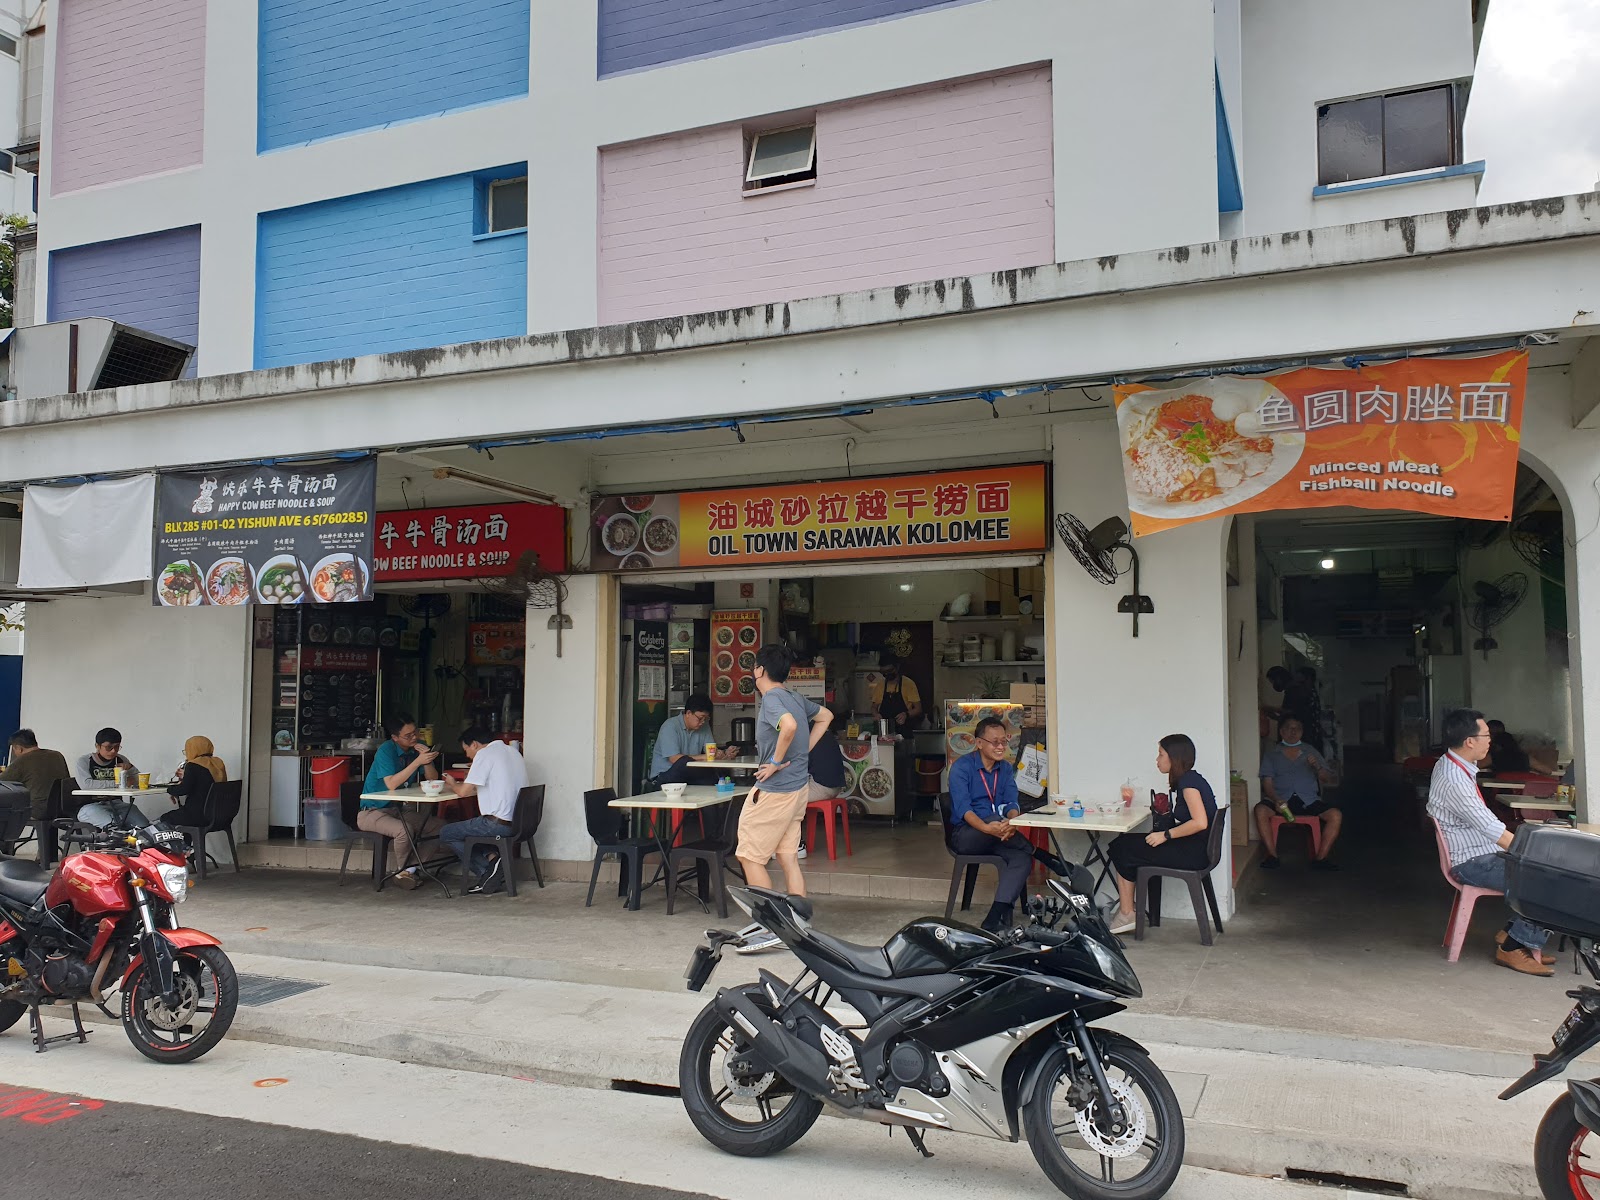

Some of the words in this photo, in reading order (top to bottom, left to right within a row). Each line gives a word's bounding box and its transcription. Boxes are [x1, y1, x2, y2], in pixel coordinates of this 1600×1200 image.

[1255, 382, 1511, 433] 鱼圆肉脞面
[1309, 461, 1381, 476] Minced
[1387, 459, 1440, 475] Meat
[222, 473, 338, 497] 快乐牛牛骨汤面
[1300, 476, 1376, 492] Fishball
[1383, 477, 1455, 497] Noodle
[218, 501, 240, 512] HAPPY
[242, 500, 259, 511] COW
[260, 499, 276, 510] BEEF
[277, 498, 308, 508] NOODLE
[309, 498, 315, 508] &
[316, 496, 336, 507] SOUP
[708, 480, 1011, 531] 油城砂拉越干捞面
[164, 522, 182, 533] BLK
[183, 520, 199, 532] 285
[201, 518, 235, 531] #01-02
[237, 516, 277, 529] YISHUN
[278, 515, 302, 527] AVE
[303, 515, 311, 526] 6
[312, 510, 368, 527] S(760285)
[378, 513, 509, 550] 牛牛骨汤面
[708, 535, 740, 557] OIL
[743, 531, 799, 555] TOWN
[803, 524, 902, 551] SARAWAK
[907, 517, 1010, 546] KOLOMEE
[373, 557, 389, 572] OW
[392, 555, 418, 571] BEEF
[421, 552, 464, 569] NOODLE
[467, 552, 476, 567] &
[479, 550, 511, 567] SOUP
[639, 630, 665, 648] Carlsberg
